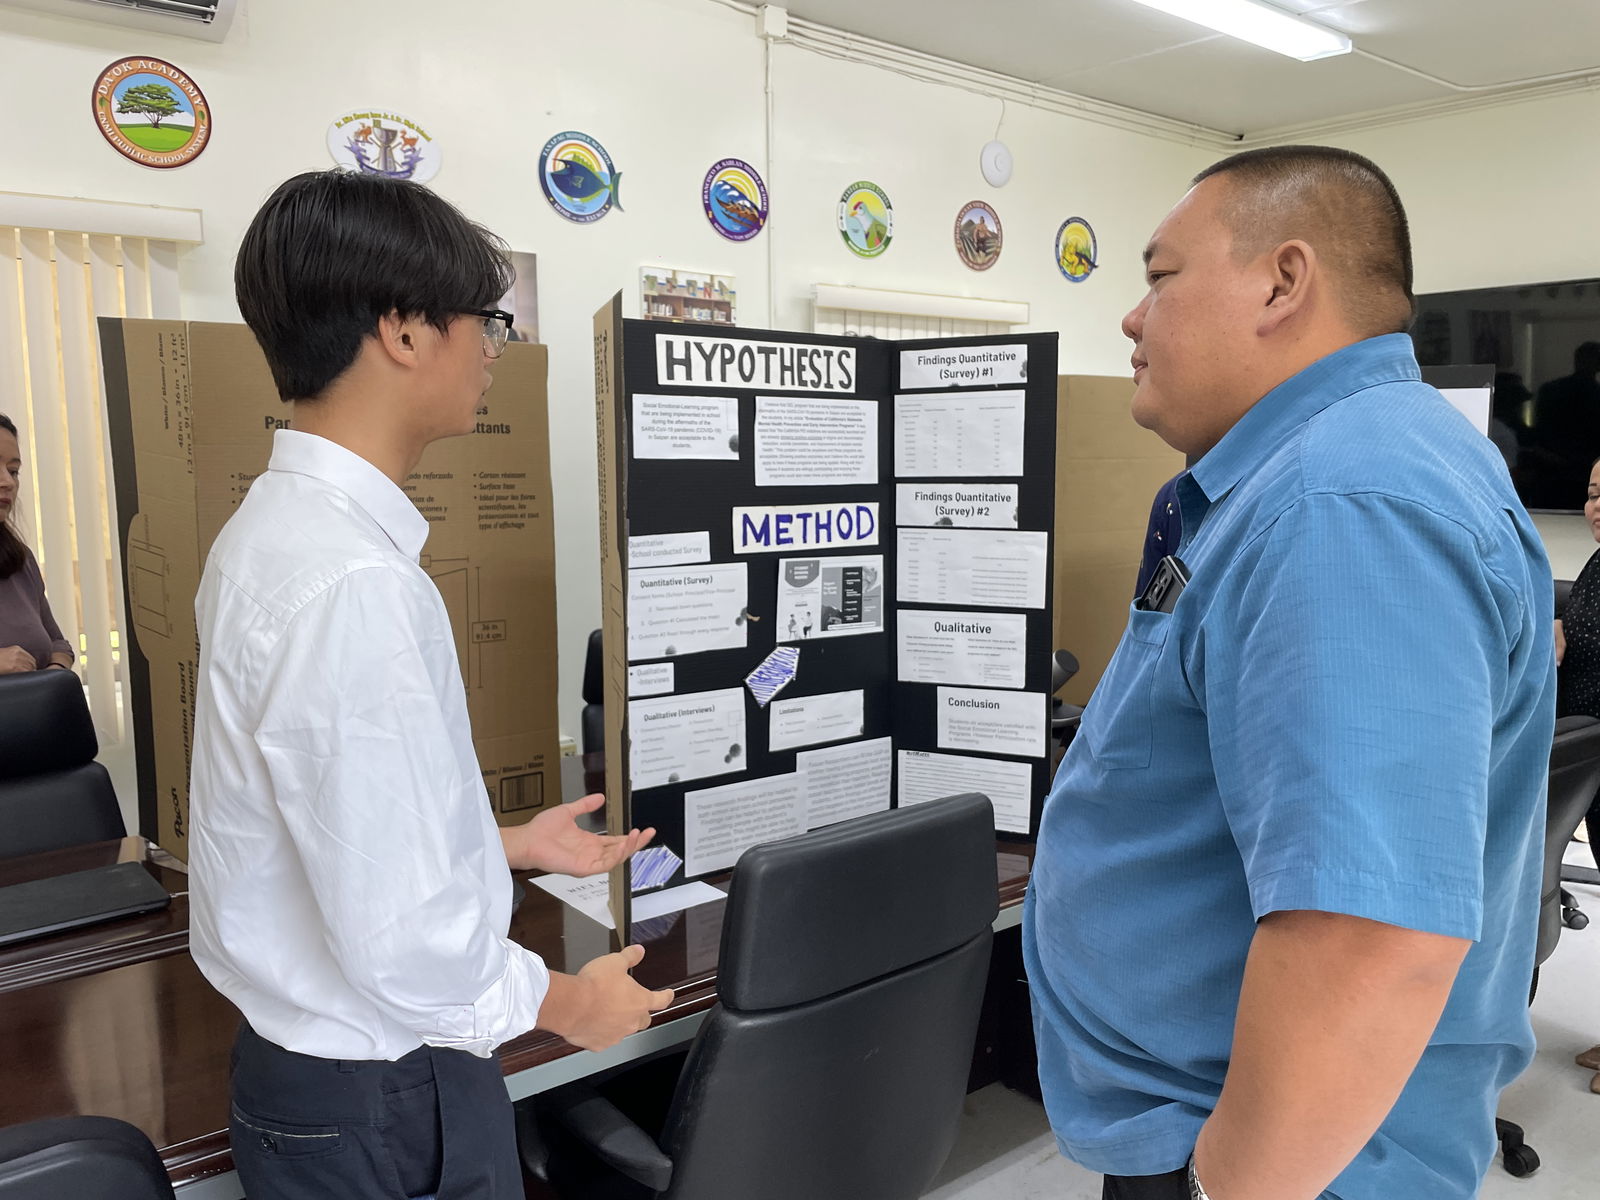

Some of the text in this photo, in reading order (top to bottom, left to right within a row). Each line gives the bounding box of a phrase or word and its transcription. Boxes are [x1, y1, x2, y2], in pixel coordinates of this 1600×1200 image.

[97, 60, 203, 106] DA'OK ACADEMY
[113, 135, 146, 159] PUBLIC
[148, 152, 186, 163] SCHOOL
[186, 125, 208, 156] SYSTEM
[665, 340, 852, 390] HYPOTHESIS
[917, 351, 1016, 366] Findings Quantitative
[939, 367, 993, 380] (Survey) #1
[175, 392, 181, 406] 36
[471, 423, 511, 434] ttants
[915, 491, 1012, 503] Findings Quantitative
[935, 505, 990, 517] (Survey) #2
[742, 505, 875, 547] METHOD
[652, 548, 683, 556] conducted
[683, 546, 702, 555] Survey
[640, 575, 713, 589] Quantitative (Survey)
[934, 621, 992, 634] Qualitative
[637, 667, 668, 677] Qualitative
[178, 662, 187, 704] Board
[948, 697, 1000, 710] Conclusion
[643, 704, 715, 722] Qualitative (Interviews)
[170, 786, 184, 839] Pacon
